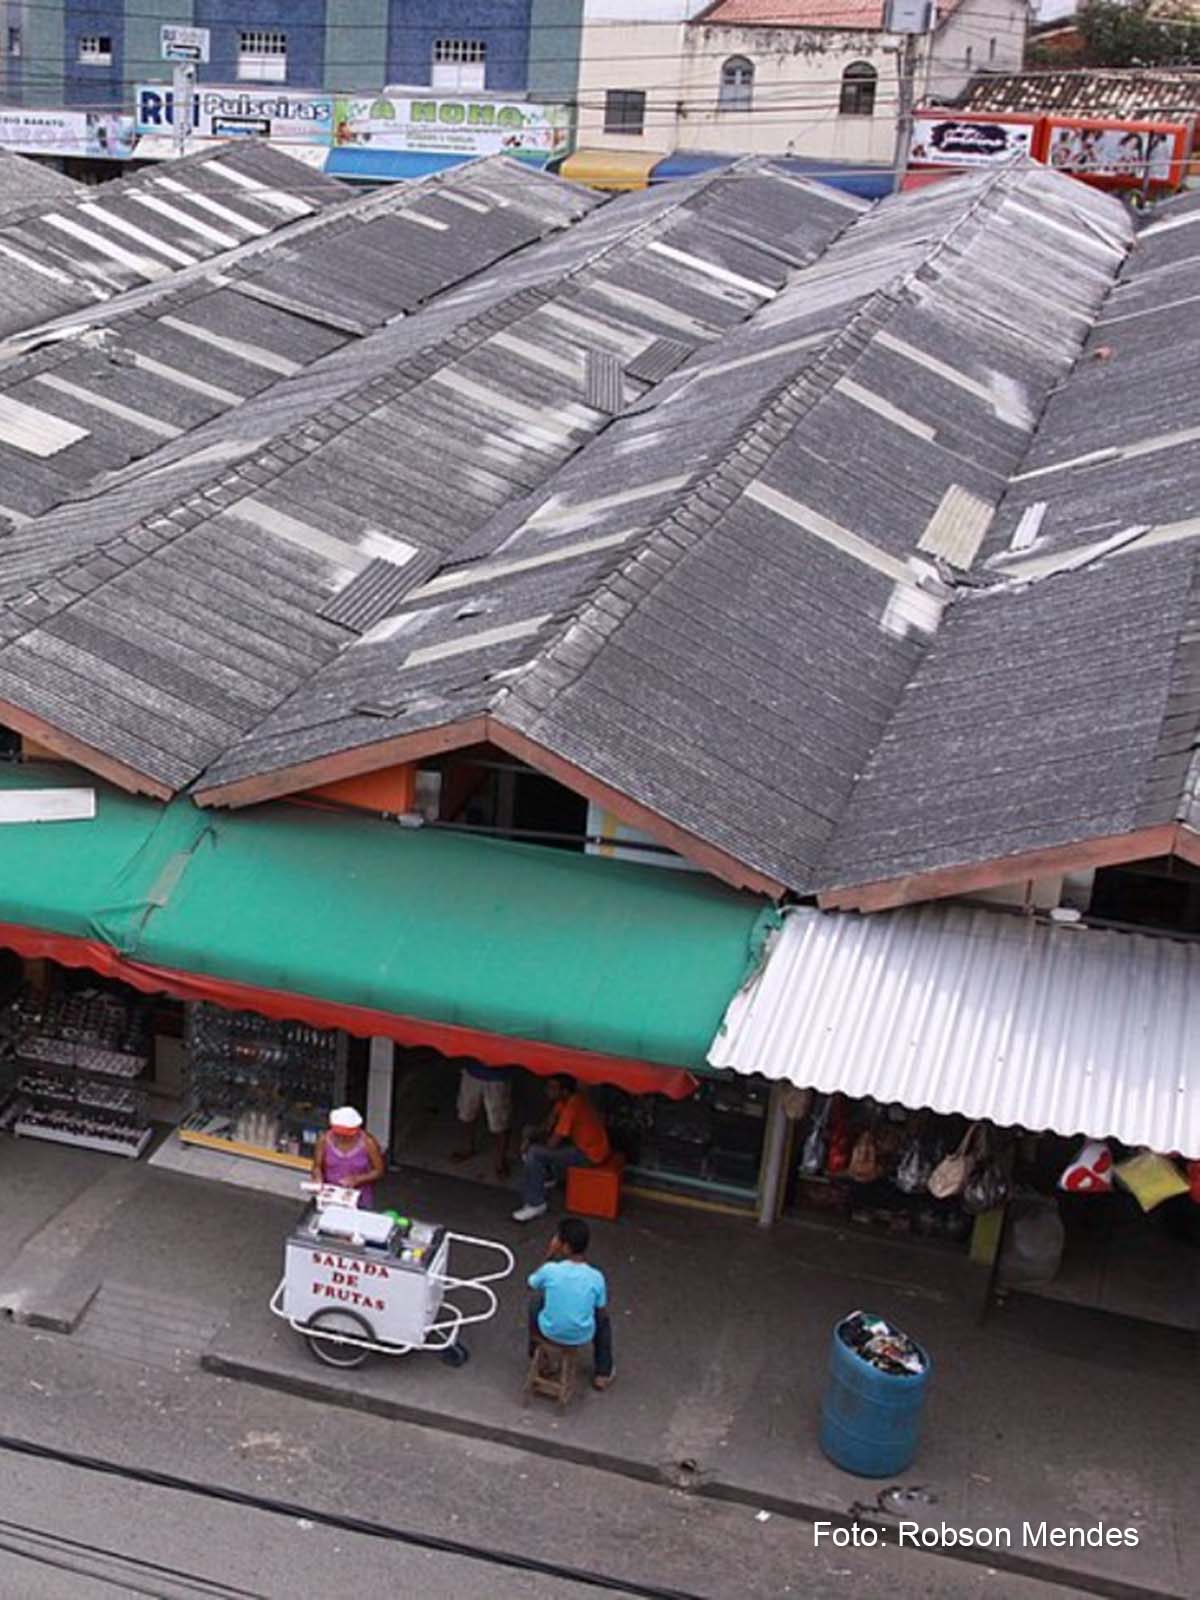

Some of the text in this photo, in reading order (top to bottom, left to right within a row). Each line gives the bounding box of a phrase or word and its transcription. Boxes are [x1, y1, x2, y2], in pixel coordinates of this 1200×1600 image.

[204, 94, 329, 121] Pulseiras
[312, 1253, 390, 1279] SALADA
[332, 1271, 359, 1287] DE
[312, 1283, 385, 1311] FRUTAS
